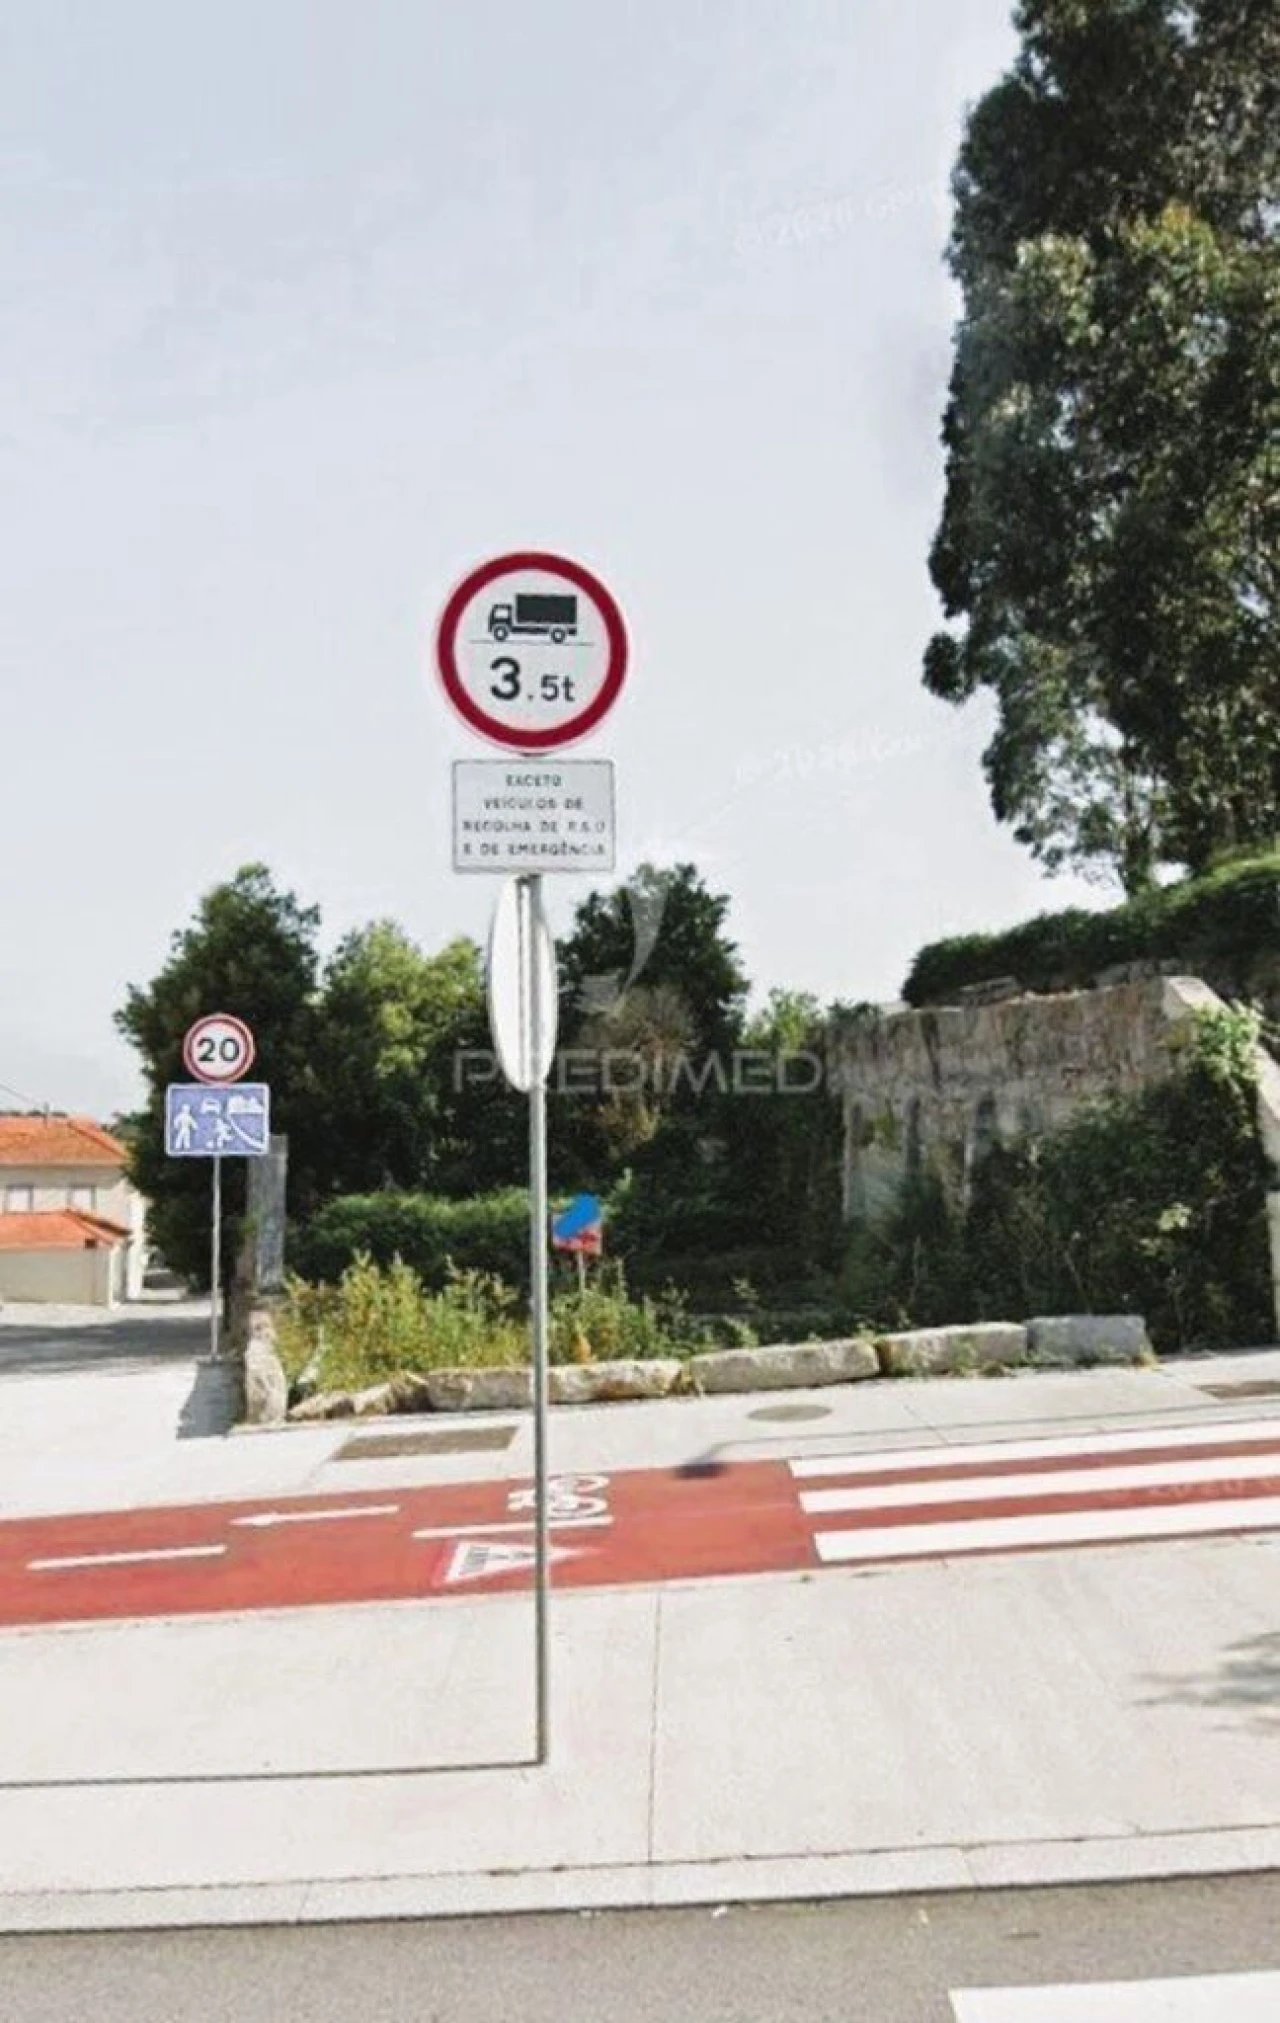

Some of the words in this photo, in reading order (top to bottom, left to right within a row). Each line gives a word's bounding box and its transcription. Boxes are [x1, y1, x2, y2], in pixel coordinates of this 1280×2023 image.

[489, 656, 576, 702] 3.5t
[564, 797, 583, 810] DE
[540, 820, 558, 833] DE
[480, 843, 499, 855] DE
[197, 1037, 240, 1062] 20
